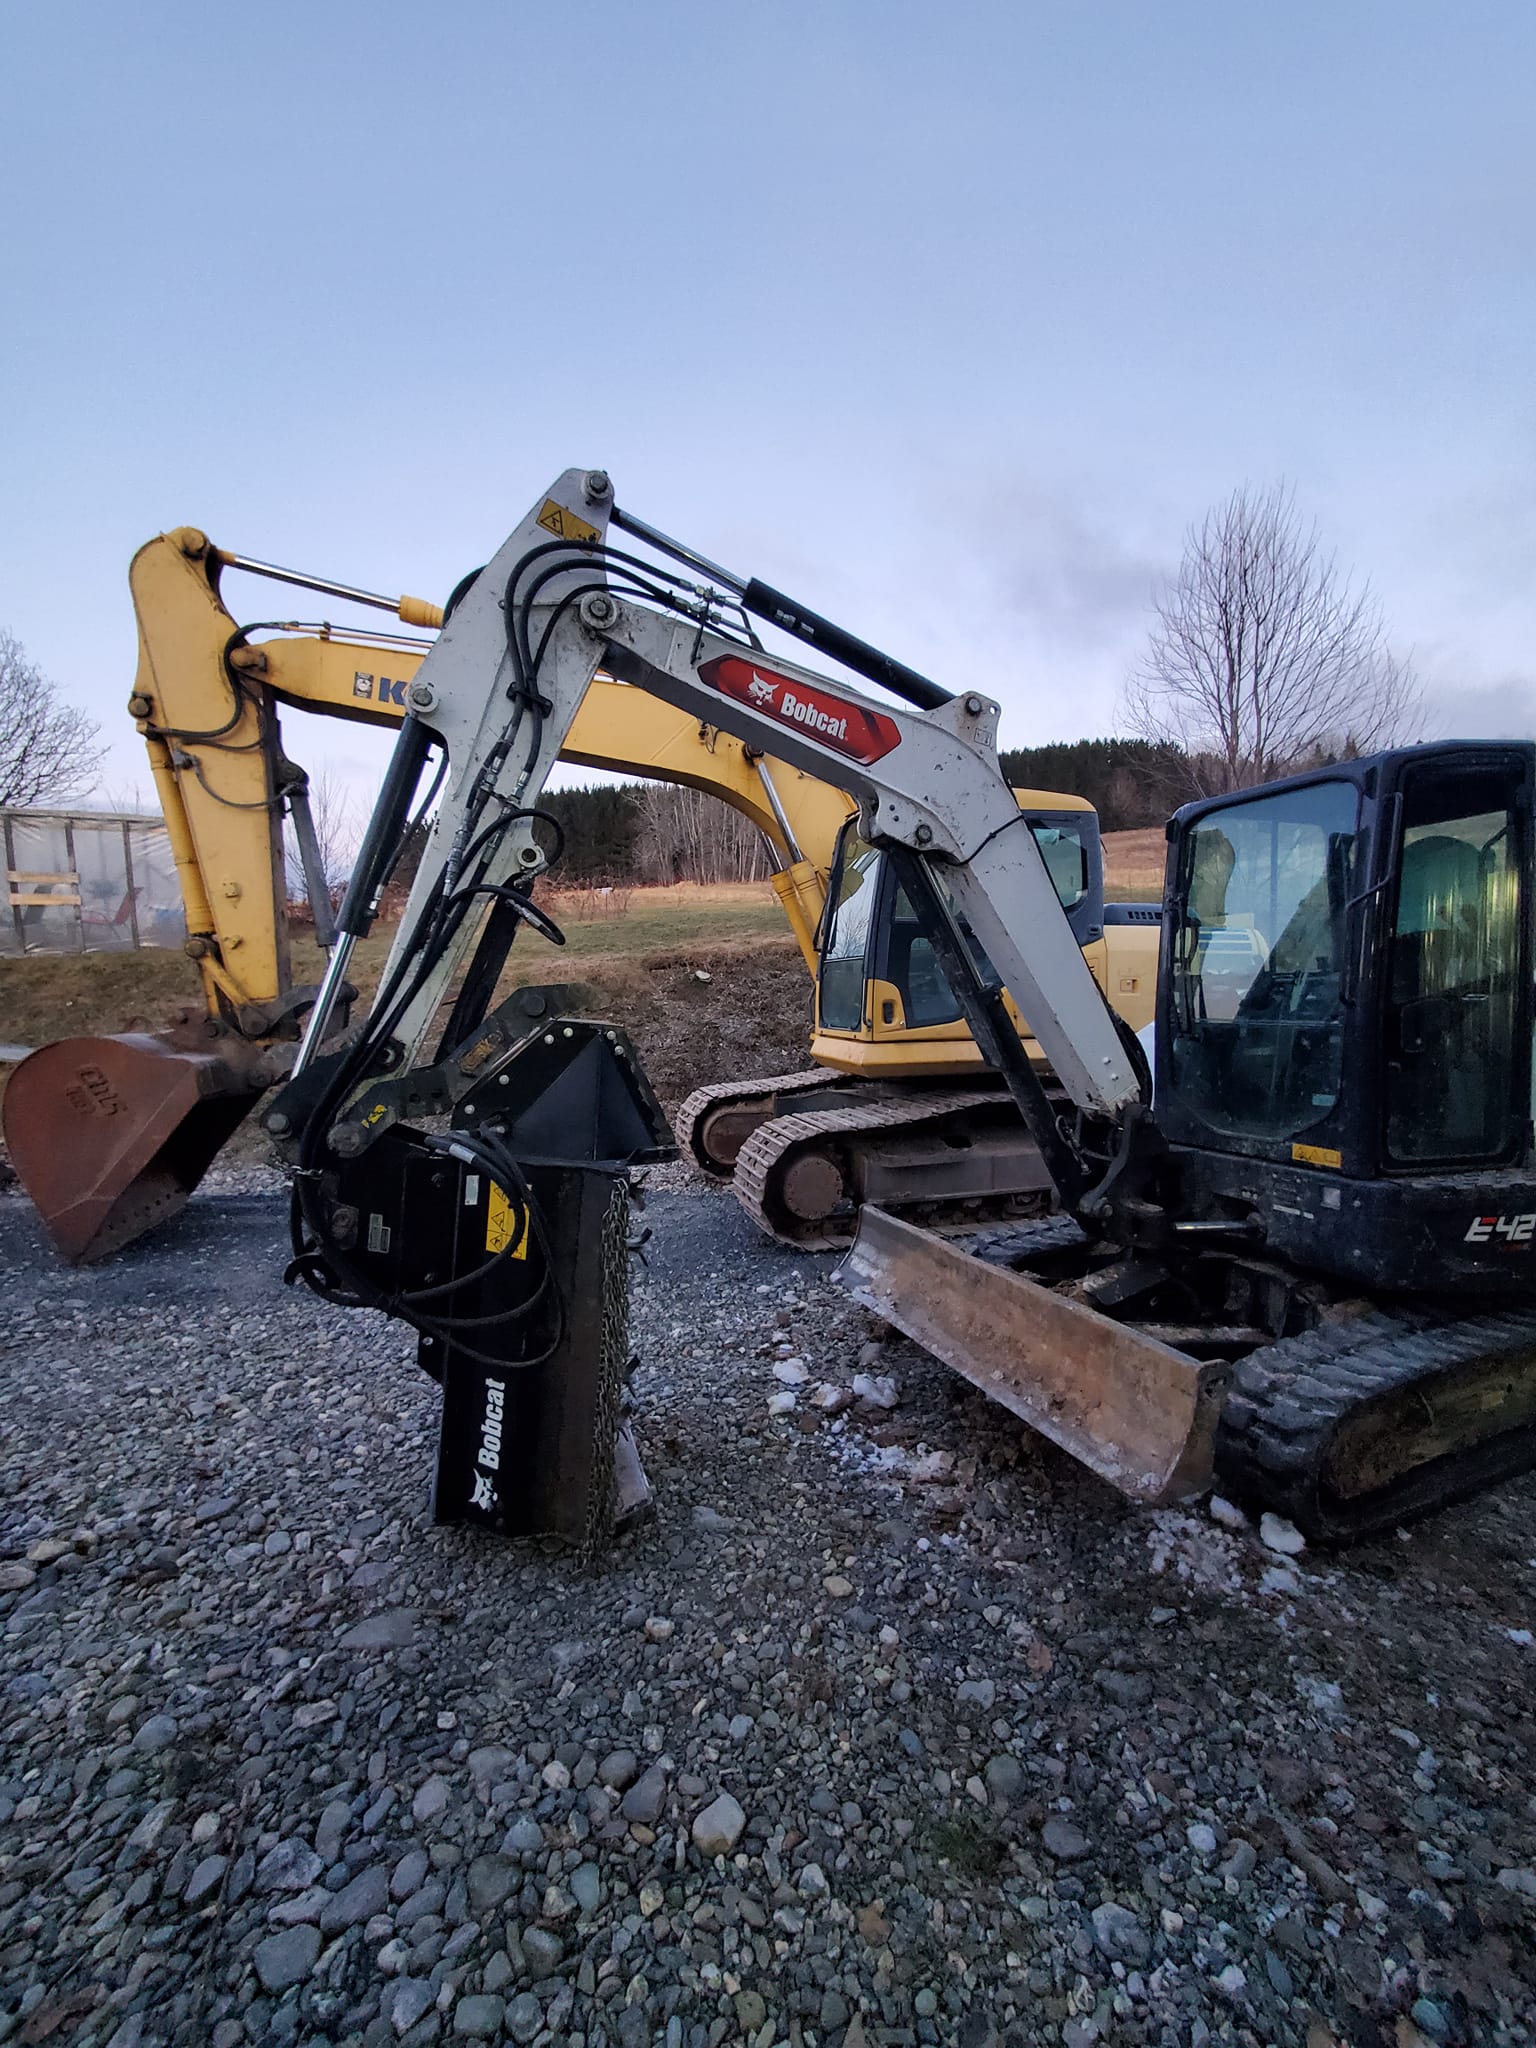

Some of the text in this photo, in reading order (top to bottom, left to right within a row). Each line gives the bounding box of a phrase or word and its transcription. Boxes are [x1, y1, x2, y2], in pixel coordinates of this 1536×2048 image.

[780, 693, 848, 740] Bobcat
[1464, 1214, 1536, 1242] E42
[478, 1378, 505, 1470] Bobcat
